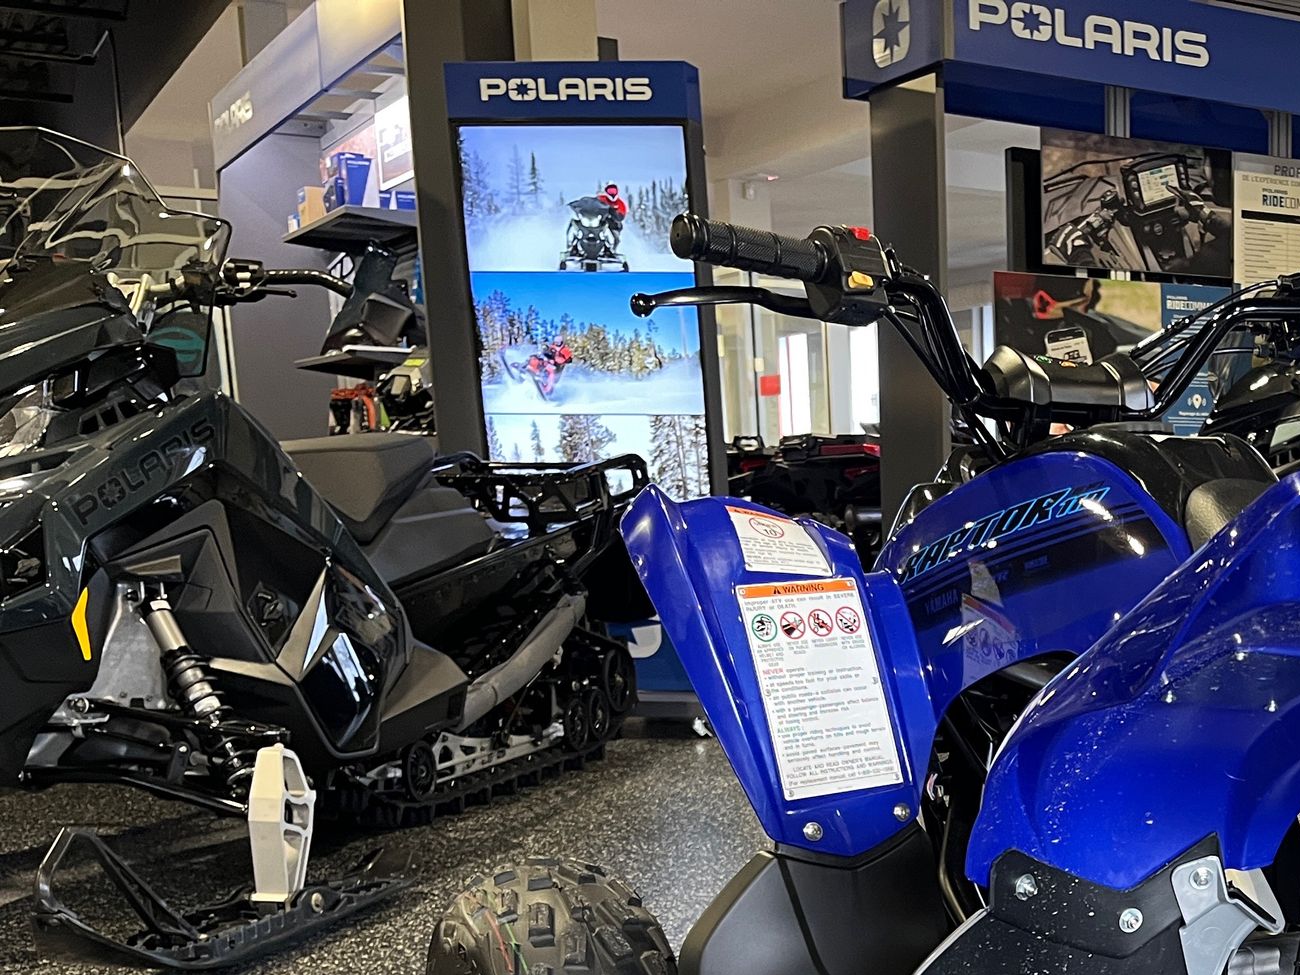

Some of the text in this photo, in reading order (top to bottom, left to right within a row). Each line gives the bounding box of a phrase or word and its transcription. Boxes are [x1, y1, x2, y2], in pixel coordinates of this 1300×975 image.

[969, 0, 1210, 67] POLARIS
[479, 78, 653, 101] POLARIS
[72, 417, 216, 526] POLARIS
[898, 487, 1072, 584] RAPTOR
[782, 583, 824, 593] WARNING
